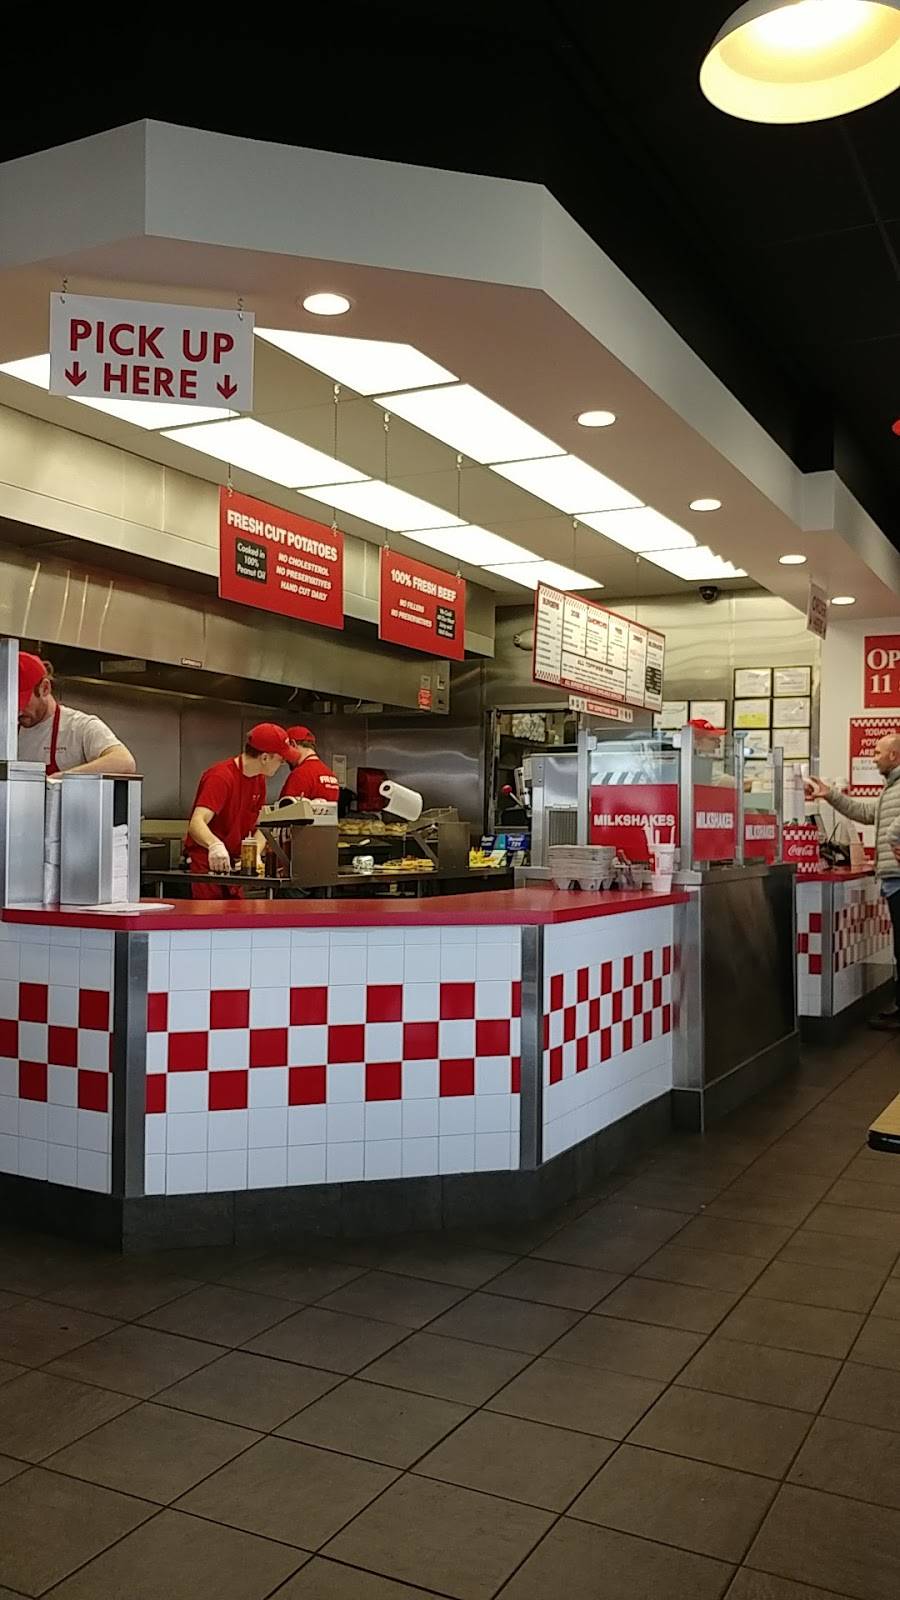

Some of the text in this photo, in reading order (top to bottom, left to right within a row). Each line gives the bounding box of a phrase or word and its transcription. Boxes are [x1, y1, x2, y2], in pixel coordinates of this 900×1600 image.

[70, 318, 234, 364] PICK UP
[103, 362, 198, 399] HERE
[227, 509, 338, 562] FRESH CUT POTATOES
[237, 542, 259, 558] Cooked
[236, 563, 266, 580] Peanut Oil
[244, 556, 260, 568] 100%
[278, 552, 330, 577] NO CHOLESTEROL
[275, 565, 332, 590] NO PRESERVATIVES
[391, 568, 457, 602] 100% FRESH BEEF
[280, 580, 328, 601] HAND CUT DAILY
[871, 673, 892, 694] 11
[593, 814, 676, 827] MILKSHAKES
[695, 811, 734, 829] MILKSHAKES
[745, 824, 775, 840] MILKSHAKES
